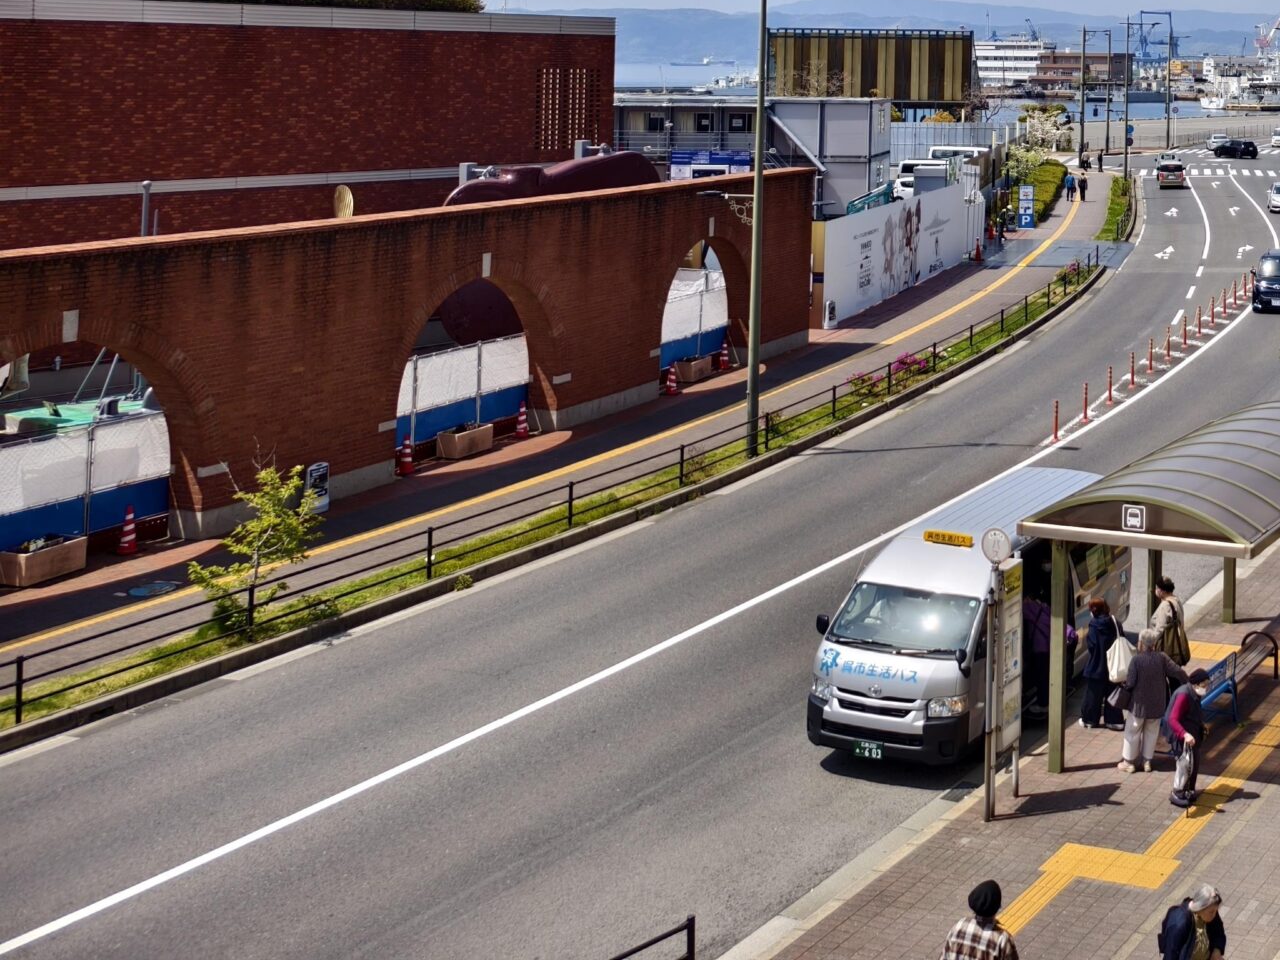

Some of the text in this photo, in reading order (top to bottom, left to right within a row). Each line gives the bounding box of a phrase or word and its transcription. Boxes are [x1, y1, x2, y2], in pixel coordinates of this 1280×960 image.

[1021, 215, 1031, 226] P
[841, 660, 918, 684] 呉市生活バス
